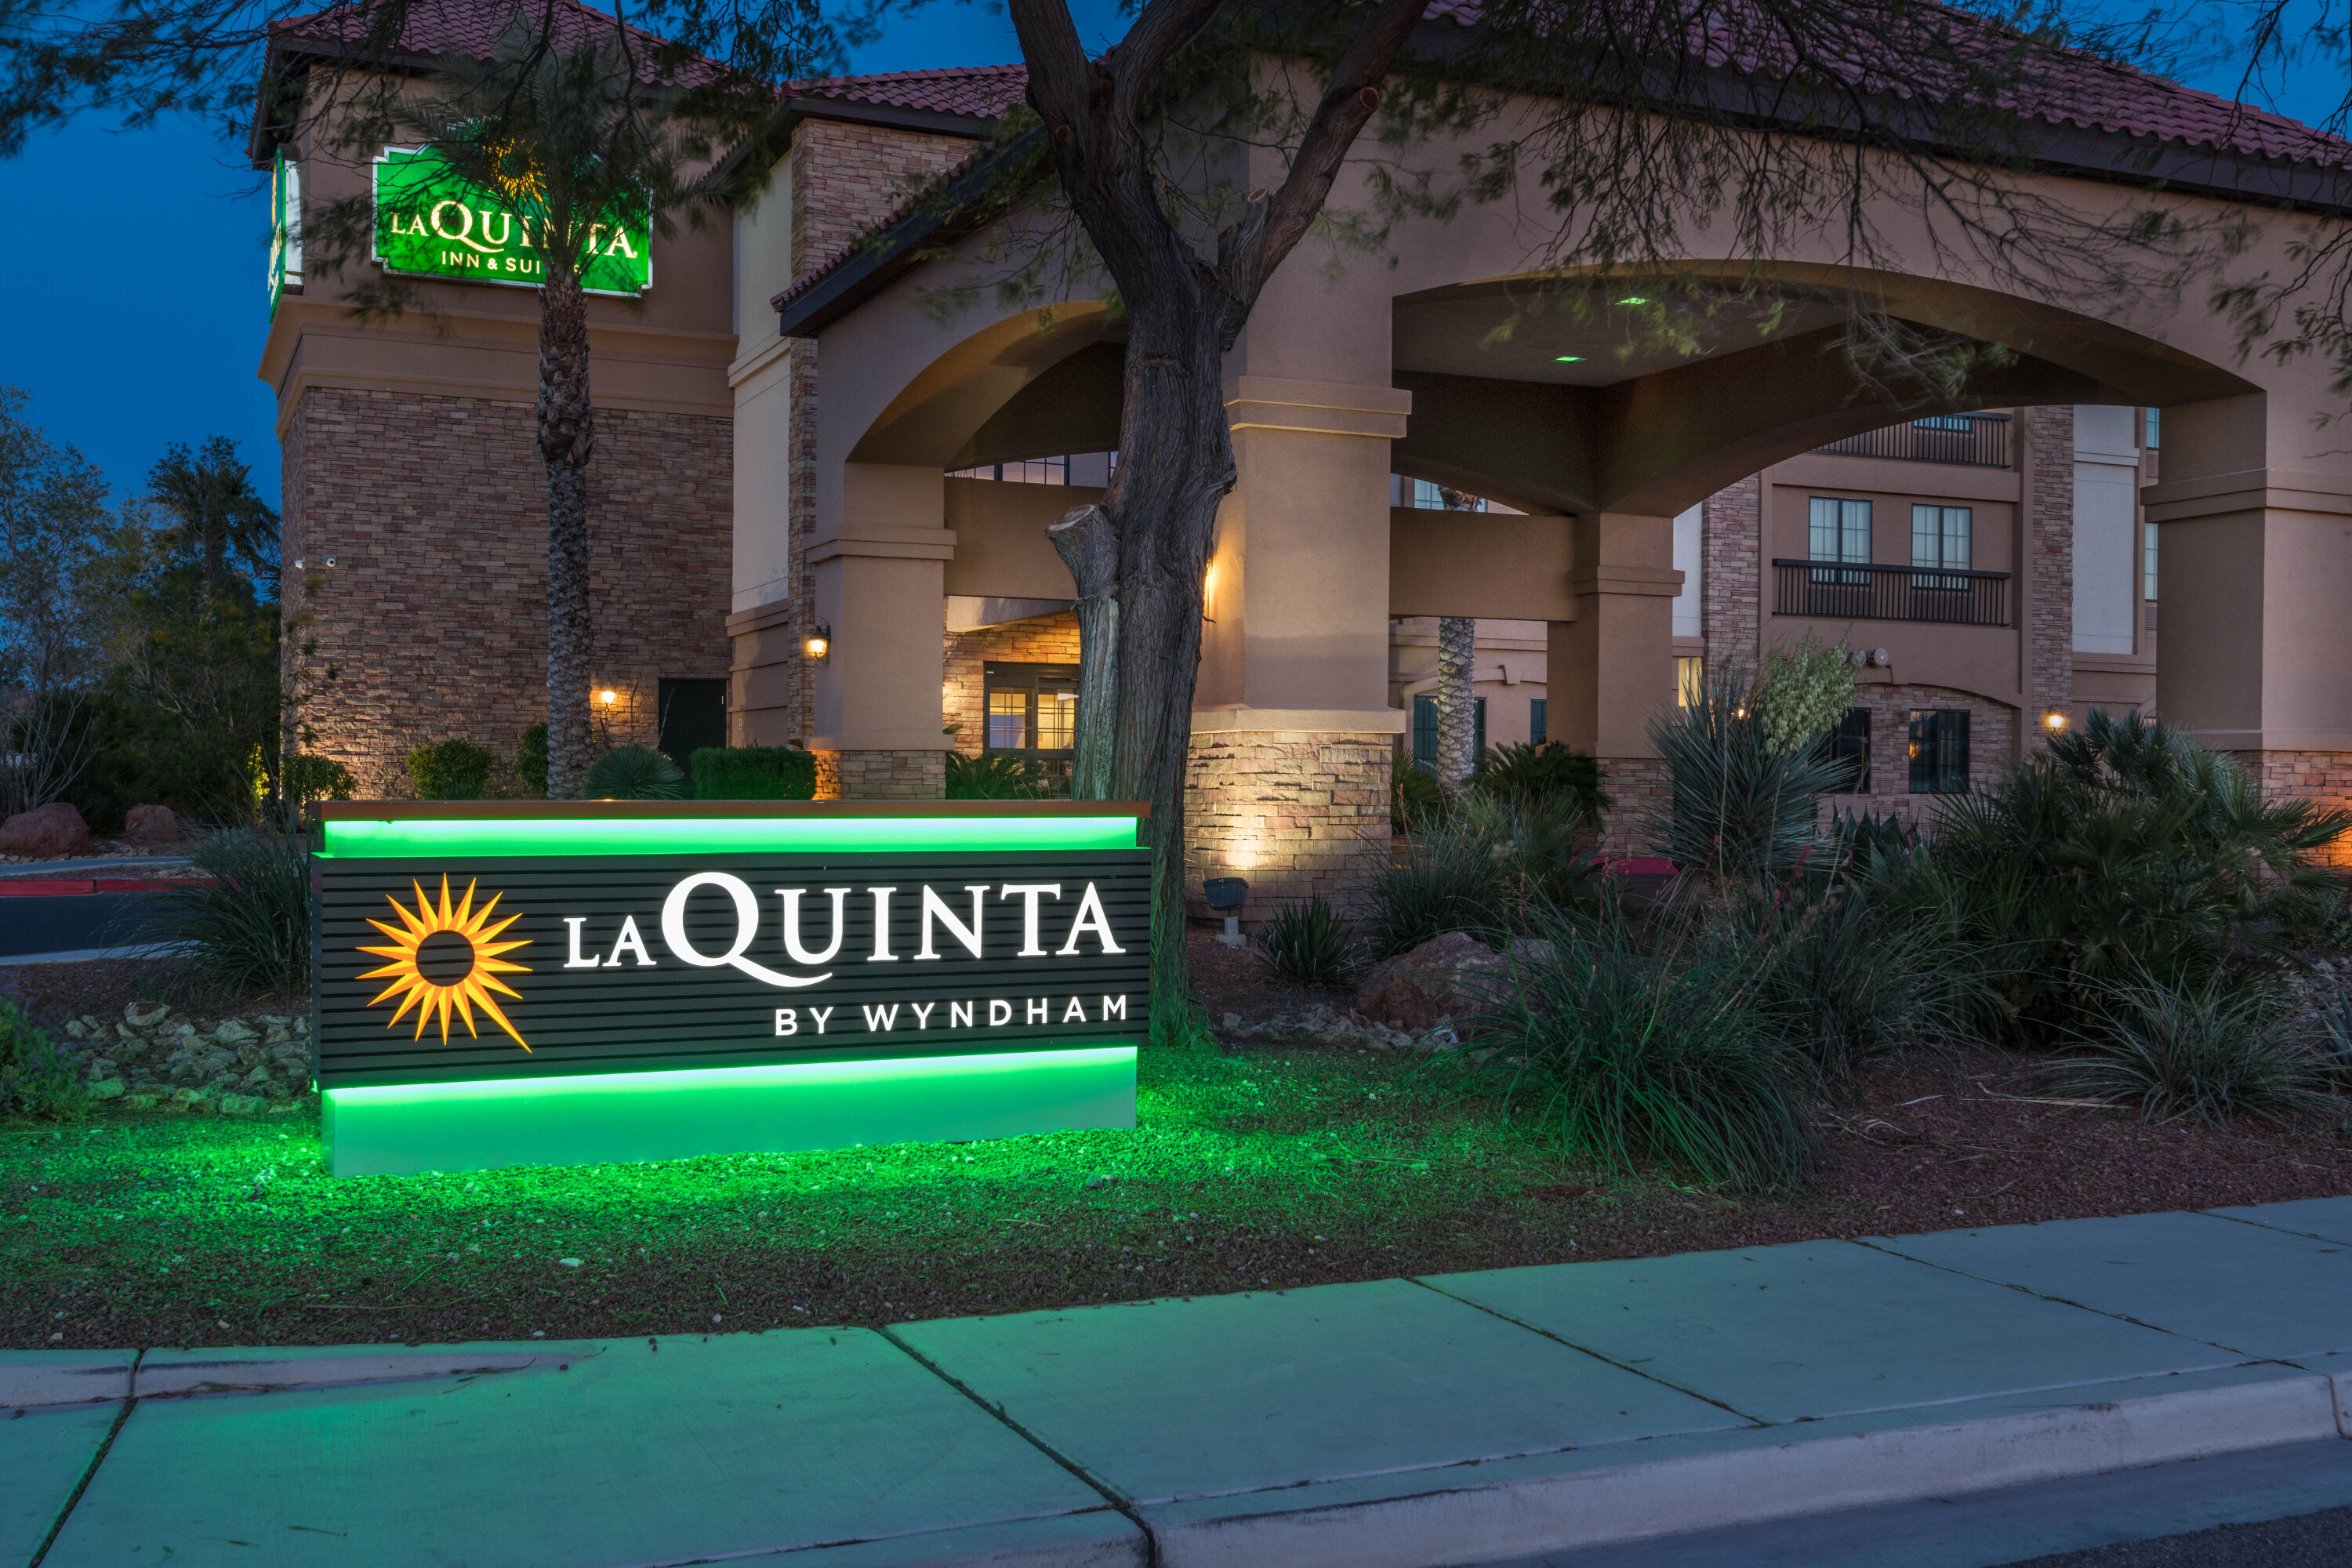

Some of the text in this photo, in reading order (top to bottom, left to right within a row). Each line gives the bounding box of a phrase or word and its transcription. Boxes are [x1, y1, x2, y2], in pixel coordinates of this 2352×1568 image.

[390, 212, 430, 236] LA
[441, 250, 480, 268] INN
[487, 257, 498, 270] &
[564, 871, 1127, 988] LA QUINTA
[775, 994, 1127, 1036] BY WYNDHAM
